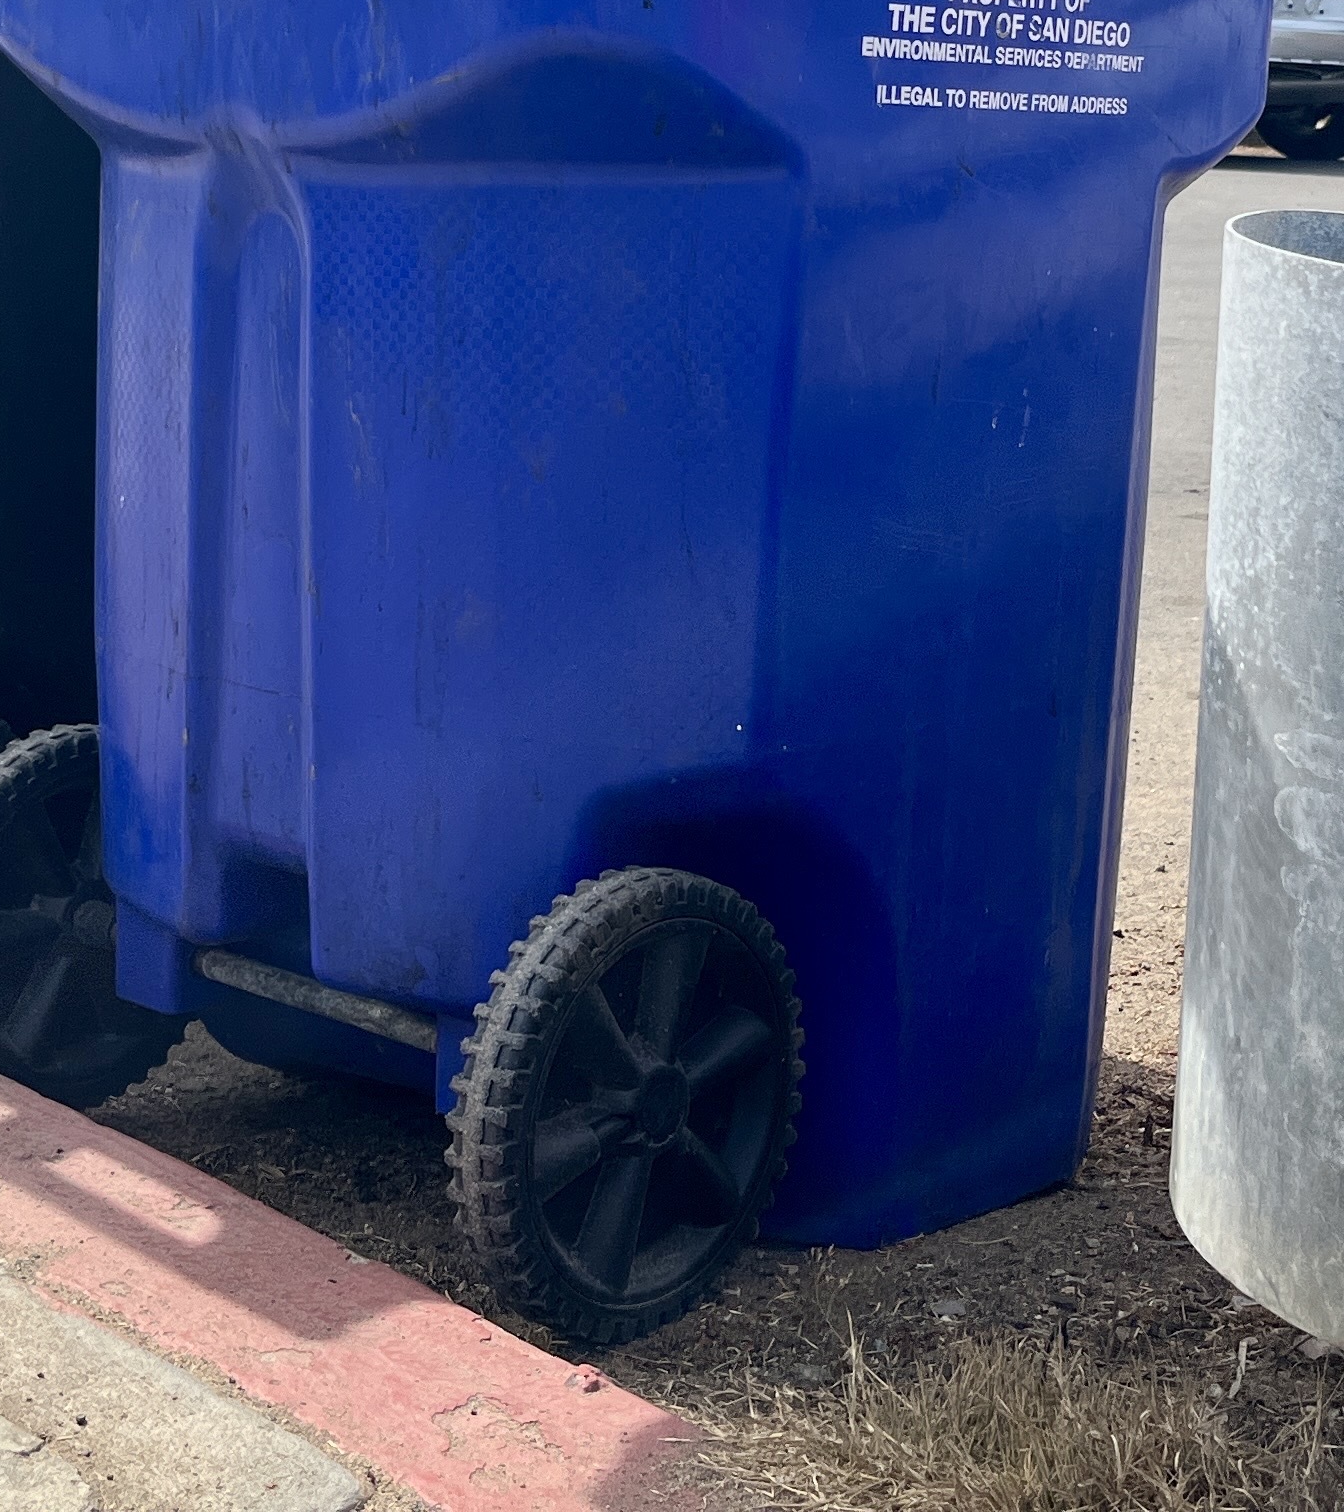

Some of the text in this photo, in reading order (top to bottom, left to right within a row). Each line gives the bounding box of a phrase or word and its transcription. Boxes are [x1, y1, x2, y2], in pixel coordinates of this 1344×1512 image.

[888, 3, 1130, 48] THE CITY OF SAN DIEGO
[861, 36, 1145, 73] ENVIRONMENTAL SERVICES DEPARTMENT
[876, 84, 1128, 115] ILLEGAL TO REMOVE FROM ADDRESS
